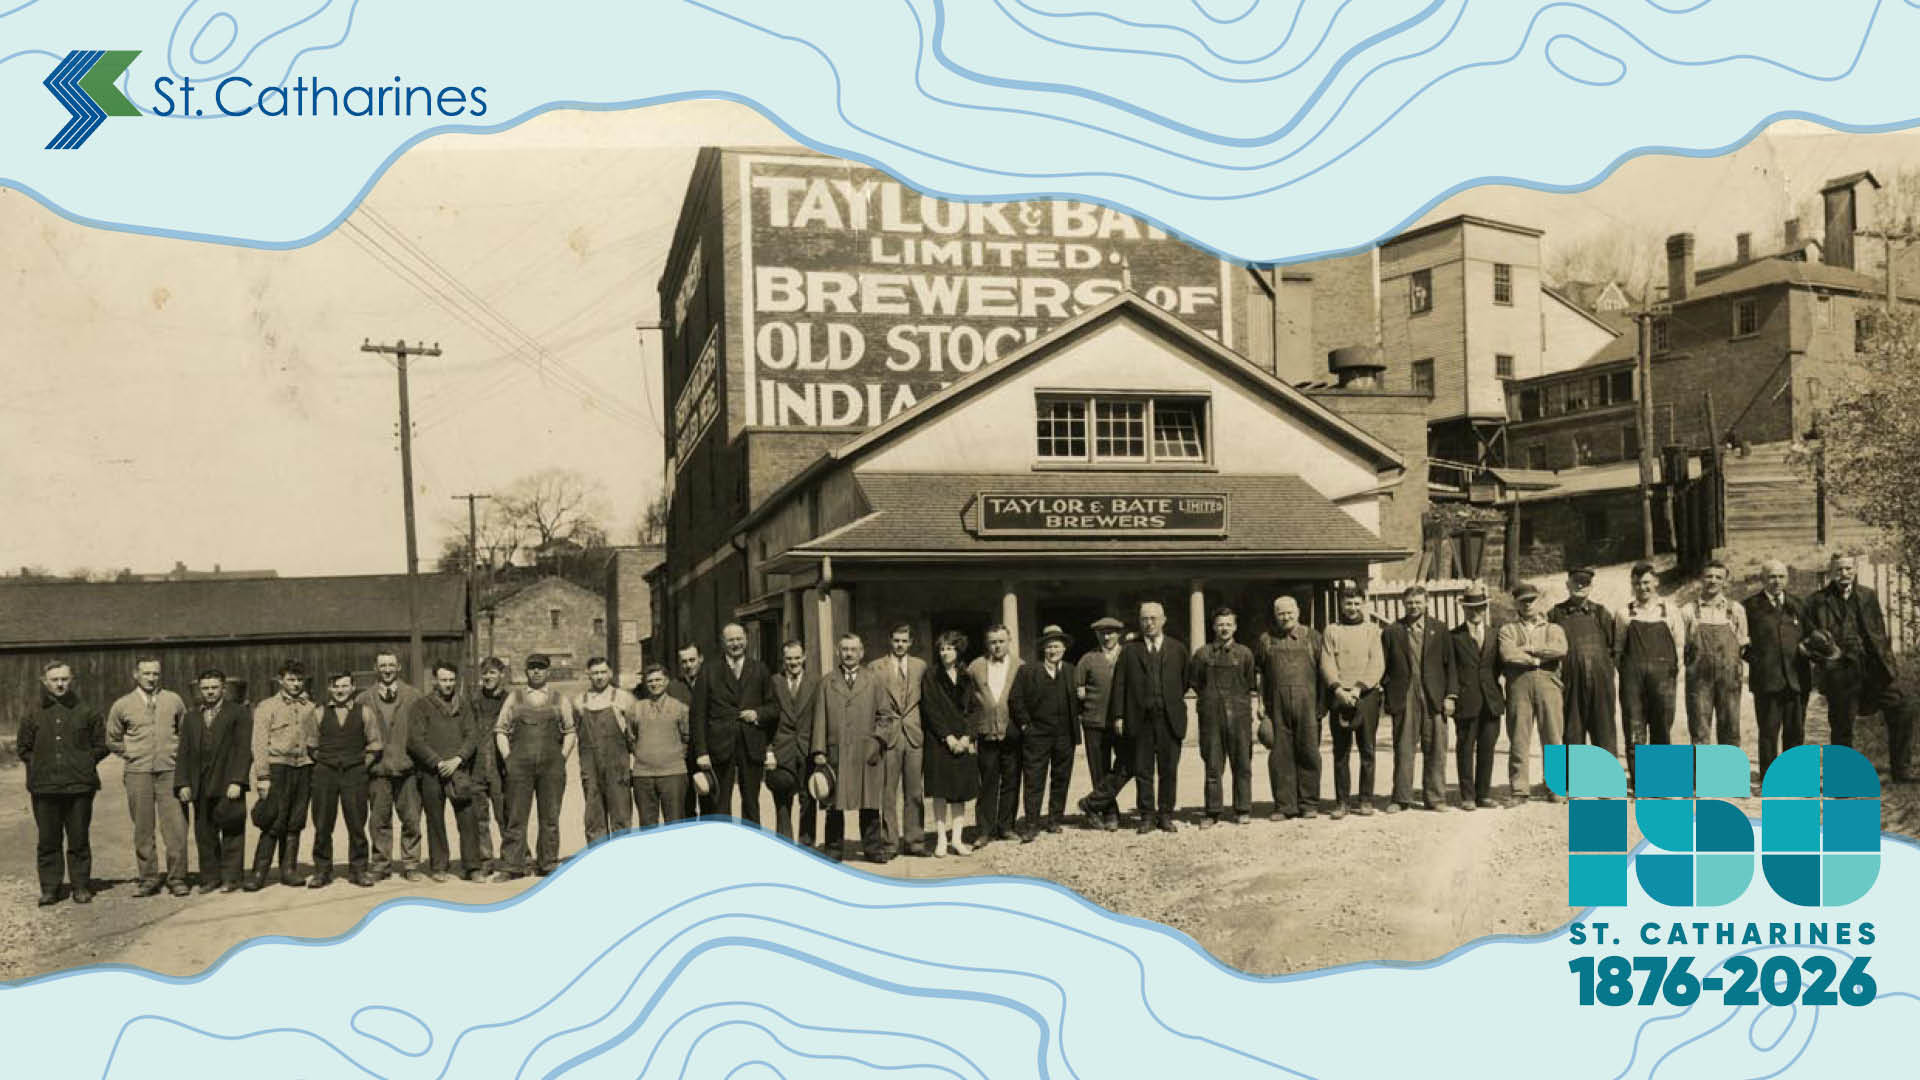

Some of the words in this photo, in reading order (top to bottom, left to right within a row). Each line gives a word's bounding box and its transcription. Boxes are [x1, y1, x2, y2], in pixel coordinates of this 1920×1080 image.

[753, 176, 1017, 236] TAYLOR
[756, 266, 1123, 317] BREWERS
[1146, 285, 1217, 313] OF
[757, 321, 865, 370] OLD
[886, 325, 1050, 372] STOC
[989, 499, 1083, 514] TAYLOR
[1112, 499, 1173, 514] BATE
[1179, 500, 1223, 514] LIMITED
[1046, 515, 1166, 528] BREWERS
